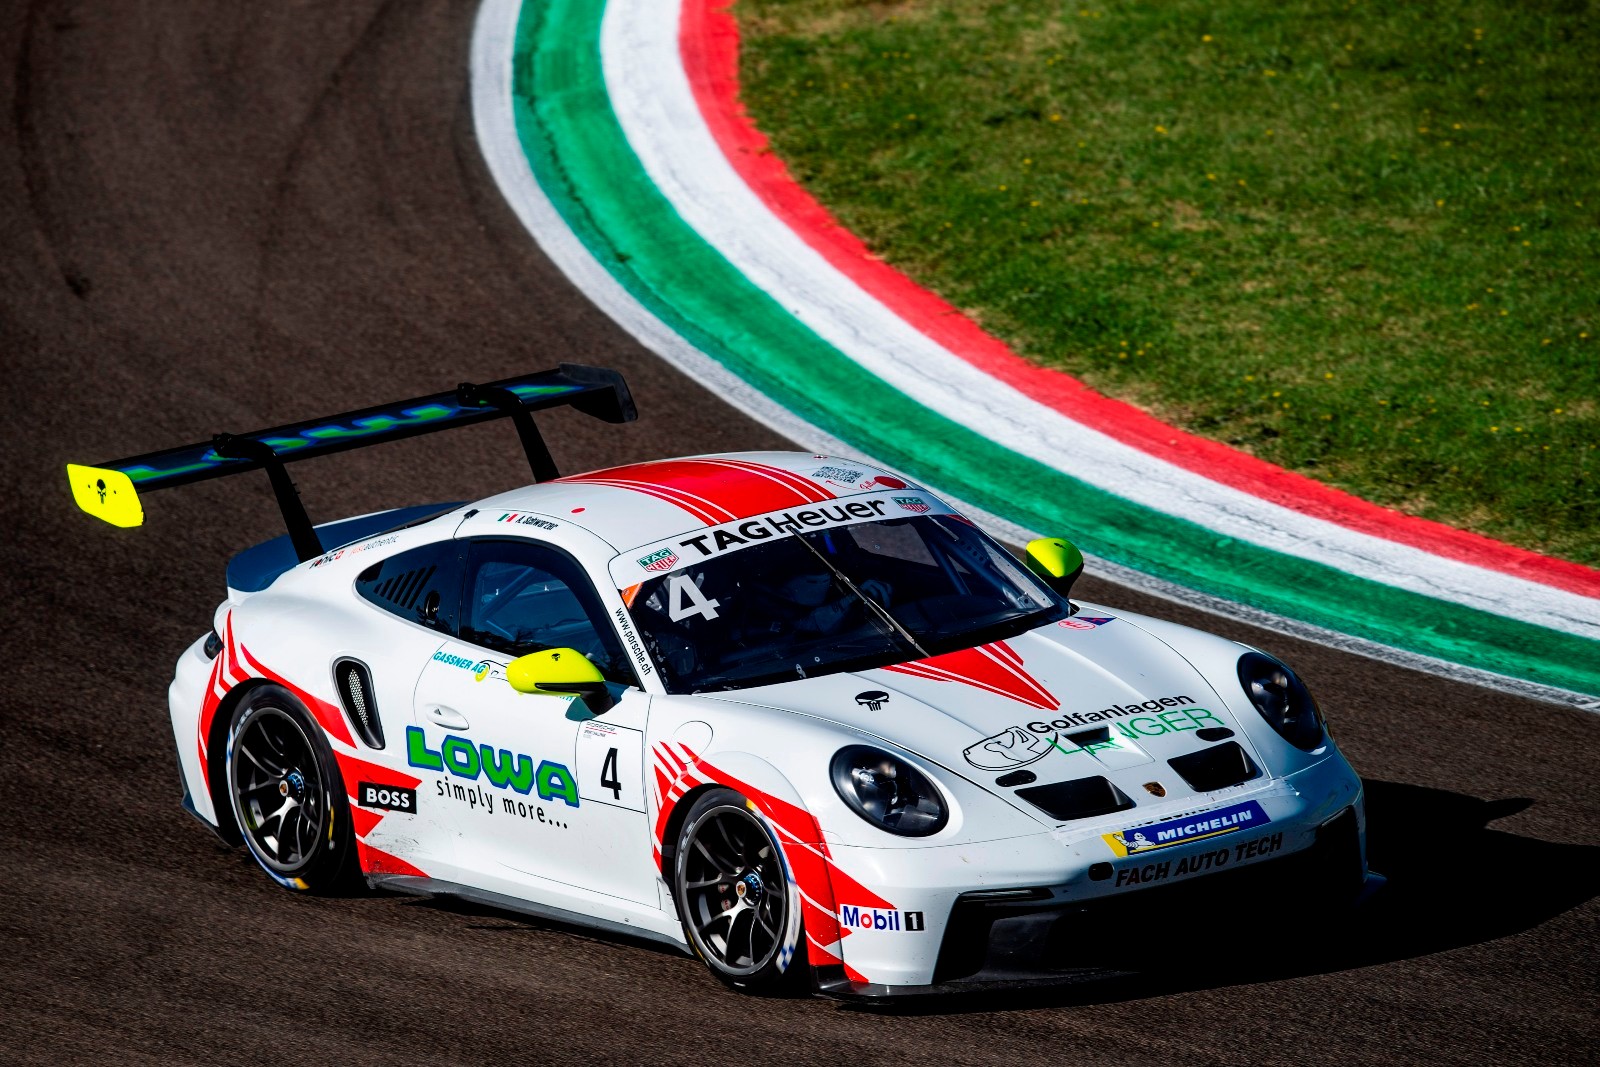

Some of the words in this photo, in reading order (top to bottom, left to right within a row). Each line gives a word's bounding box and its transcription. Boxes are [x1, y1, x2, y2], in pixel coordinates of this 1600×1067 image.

[641, 550, 670, 565] TAG
[646, 556, 677, 571] HEUER
[668, 573, 721, 623] 4
[615, 607, 653, 676] www.porsche.ch
[433, 651, 474, 670] GASSNER
[471, 663, 487, 674] AG
[1026, 695, 1197, 734] Golfanlagen
[406, 725, 580, 808] LOWA
[600, 747, 622, 800] 4
[366, 787, 410, 808] BOSS
[436, 776, 494, 815] simply
[502, 797, 568, 830] more...
[1157, 810, 1253, 841] MICHELIN
[1115, 861, 1171, 888] FACH
[1173, 848, 1230, 877] AUTO
[1235, 832, 1283, 861] TECH
[842, 905, 900, 931] Mobil
[909, 912, 919, 930] 1
